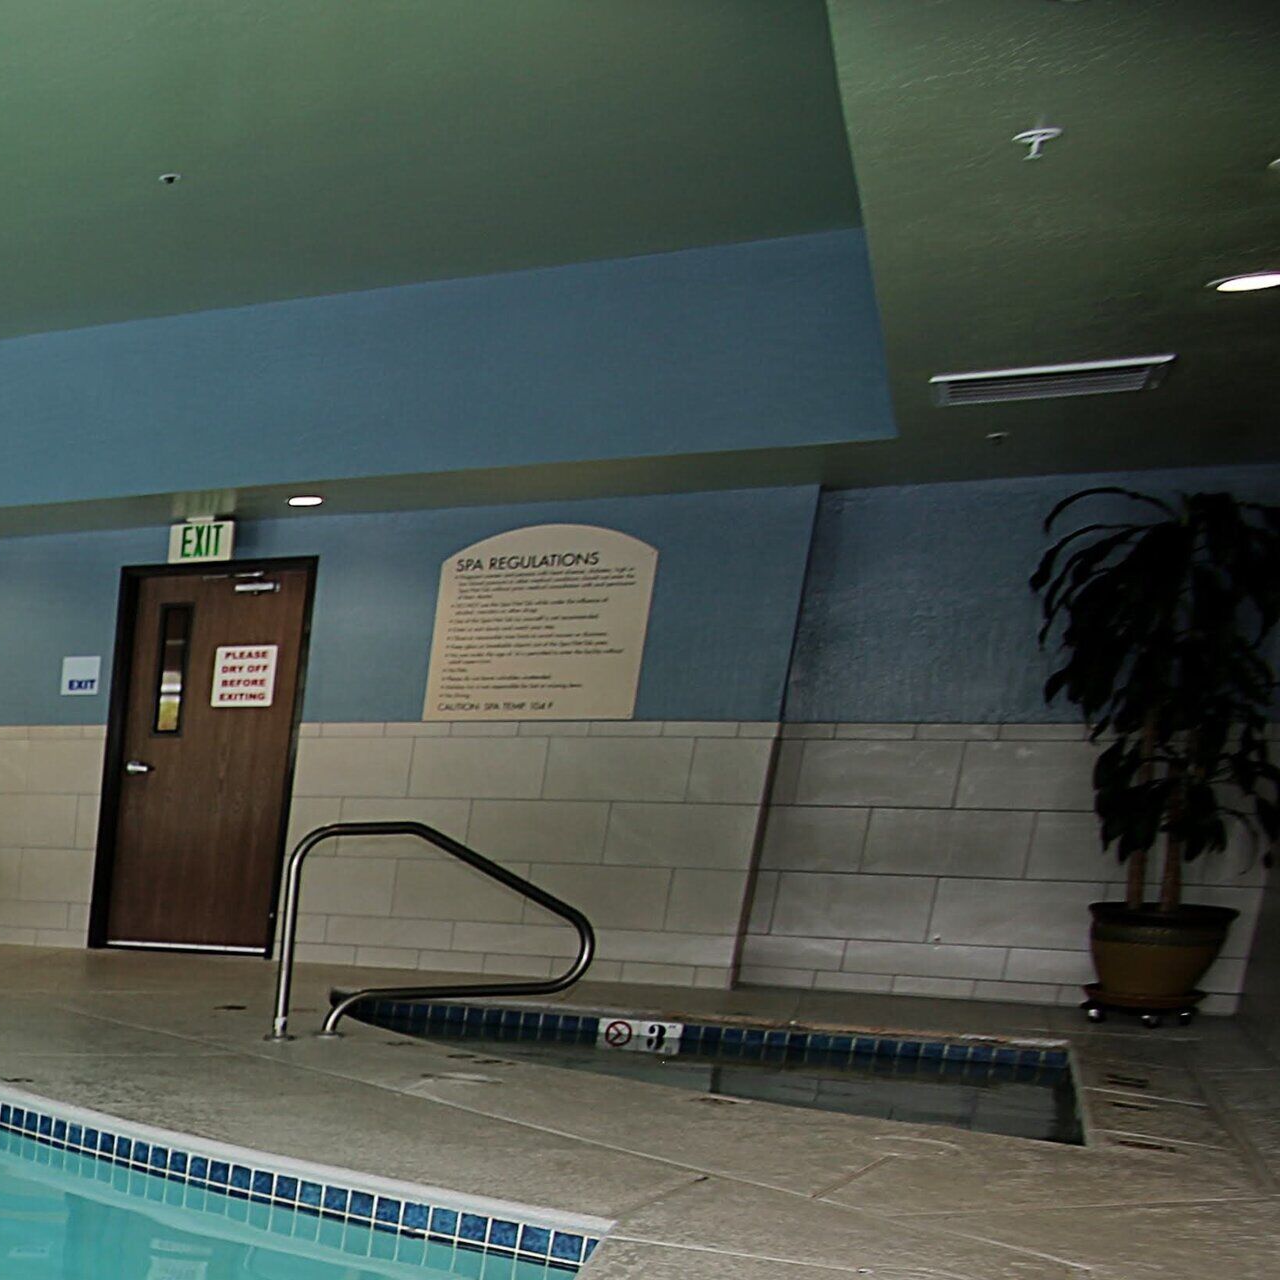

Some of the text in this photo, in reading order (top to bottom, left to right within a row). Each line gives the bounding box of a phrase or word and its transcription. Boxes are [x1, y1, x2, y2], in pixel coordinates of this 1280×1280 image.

[181, 525, 223, 557] EXIT
[456, 552, 600, 572] SPA REGULATIONS
[225, 651, 268, 659] PLEASE
[222, 665, 268, 673] DRY OFF
[68, 680, 96, 690] EXIT
[221, 679, 266, 687] BEFORE
[219, 693, 266, 701] EXITING
